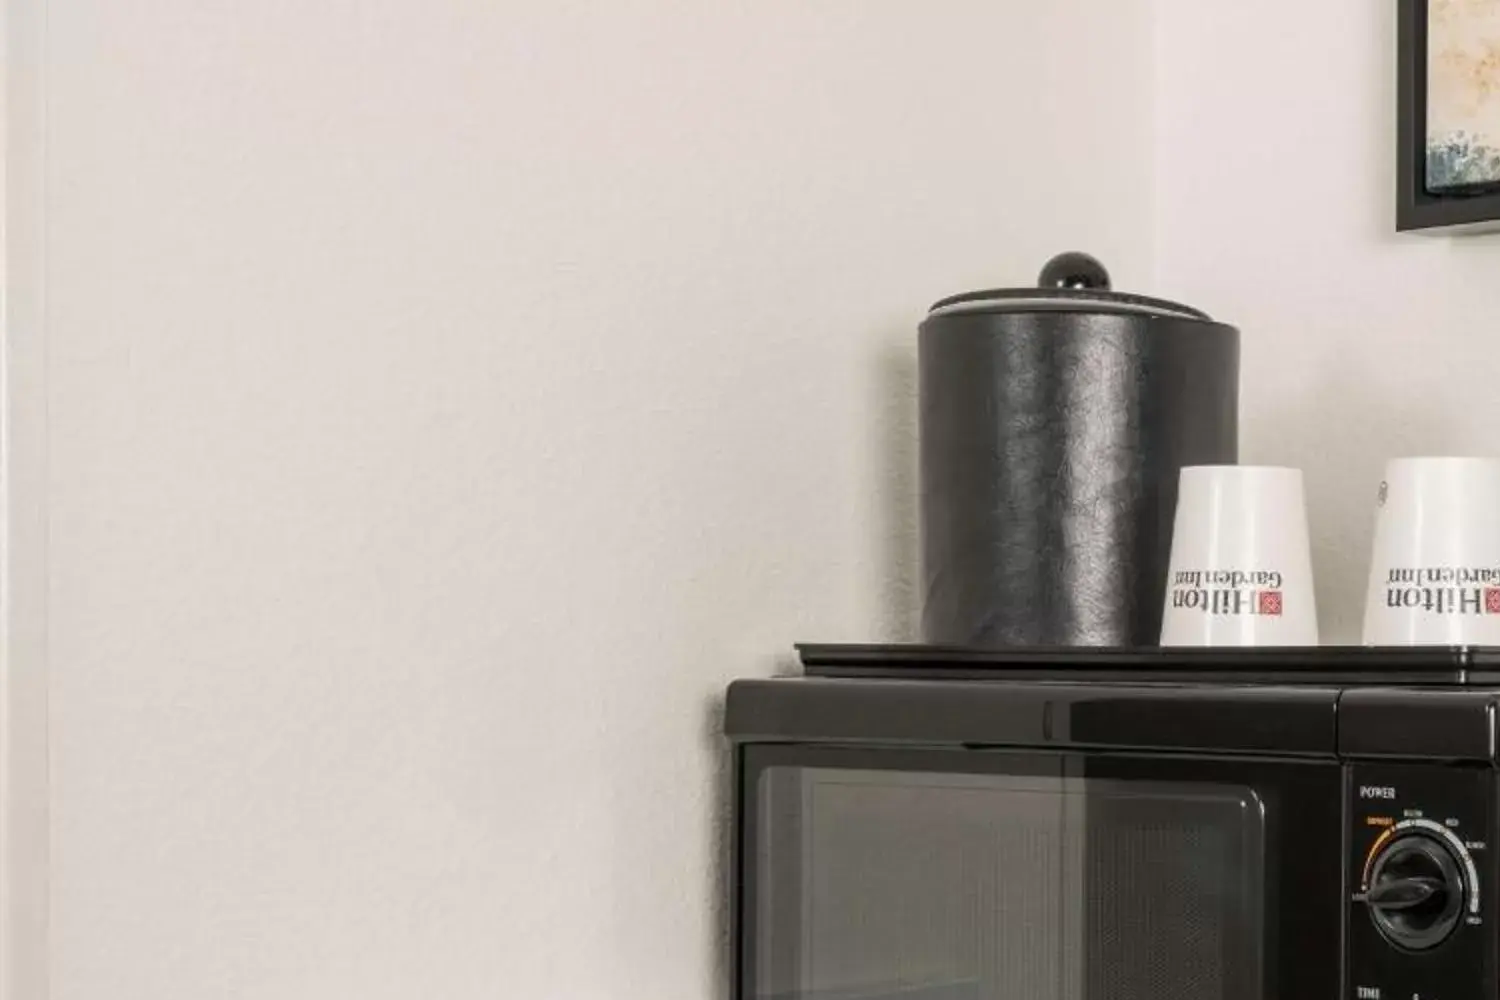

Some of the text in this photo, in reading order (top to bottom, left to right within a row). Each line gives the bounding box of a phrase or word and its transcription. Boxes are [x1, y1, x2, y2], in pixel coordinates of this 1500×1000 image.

[1203, 570, 1283, 589] Garden
[1387, 567, 1422, 587] Inn
[1173, 589, 1258, 615] Hilton
[1386, 587, 1481, 614] Hilton
[1359, 785, 1397, 800] POWER
